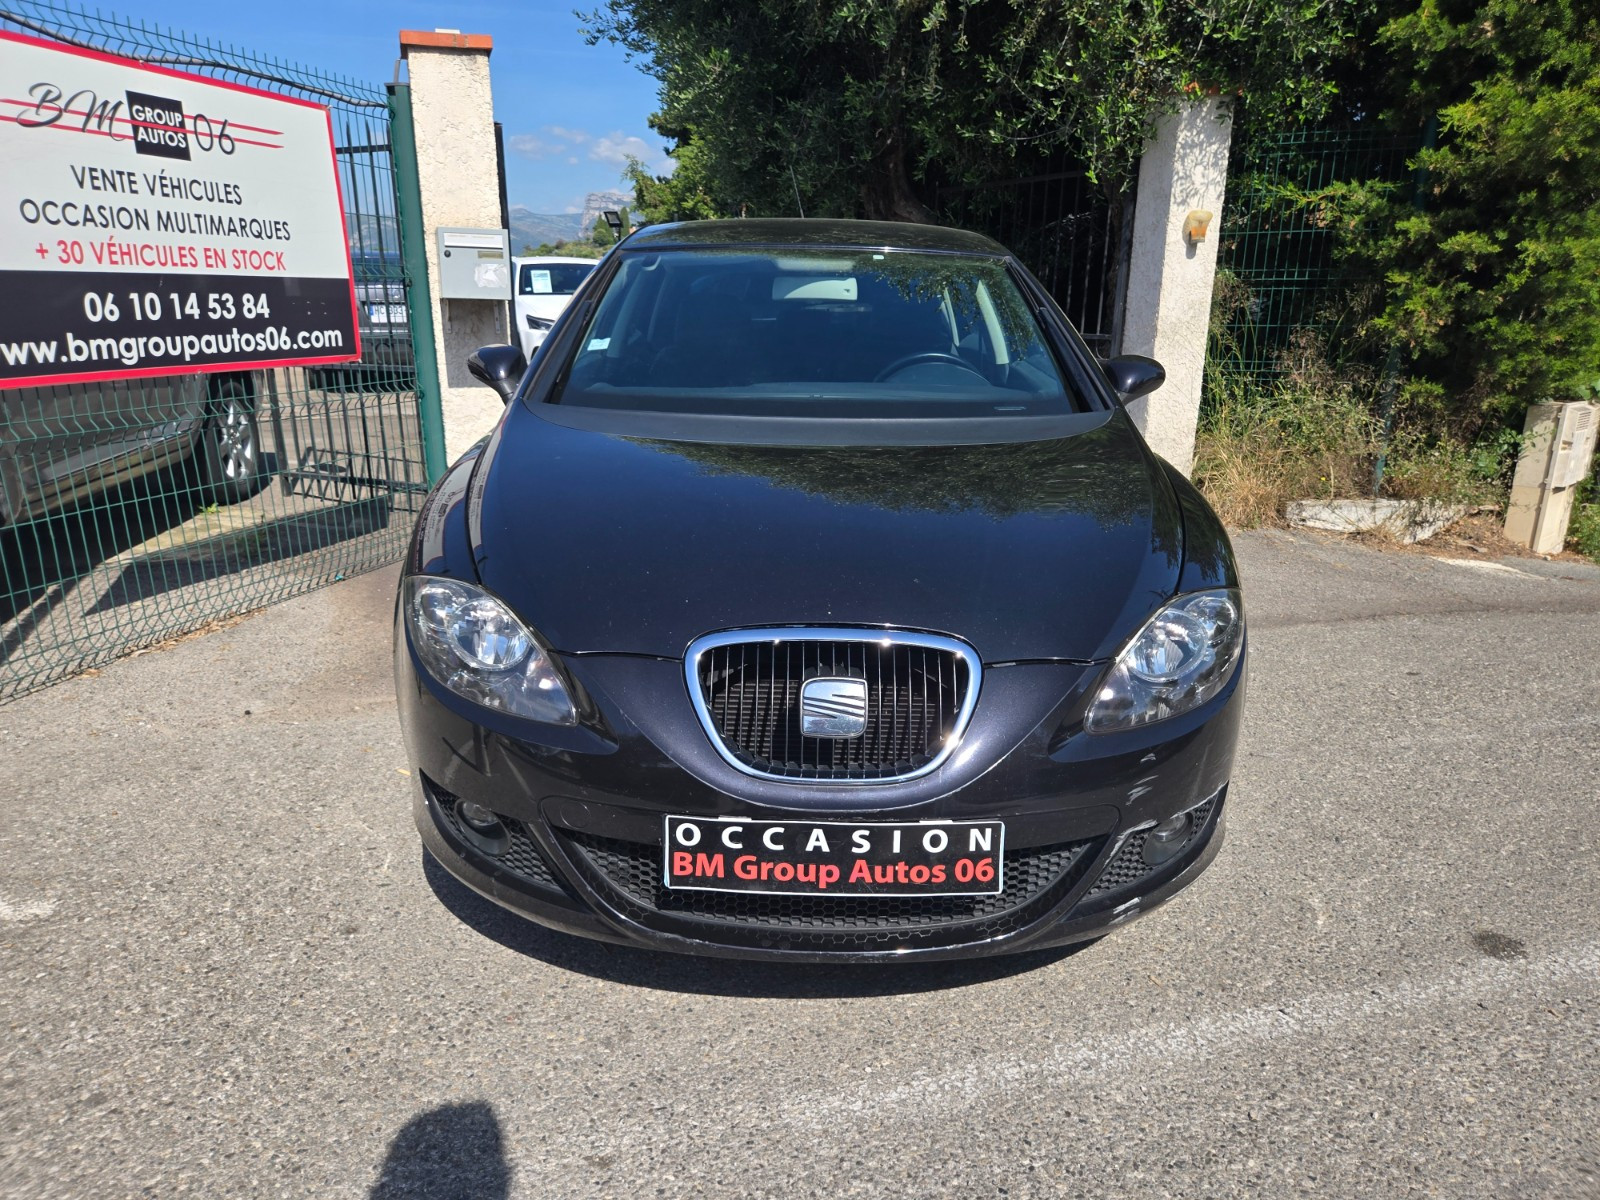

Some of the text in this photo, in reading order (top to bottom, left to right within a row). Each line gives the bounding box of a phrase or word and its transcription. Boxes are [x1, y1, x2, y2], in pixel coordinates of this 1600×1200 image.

[16, 82, 126, 141] BM
[132, 104, 183, 127] GROUP
[137, 127, 187, 148] AUTOS
[194, 113, 235, 155] 06
[70, 164, 242, 205] VENTE VÉHICULES
[19, 198, 291, 241] OCCASION MULTIMARQUES
[35, 235, 286, 271] + 30 VÉHICULES EN STOCK
[84, 291, 270, 322] 06 10 14 53 84
[675, 822, 993, 854] OCCASION
[672, 851, 995, 889] BM Group Autos 06
